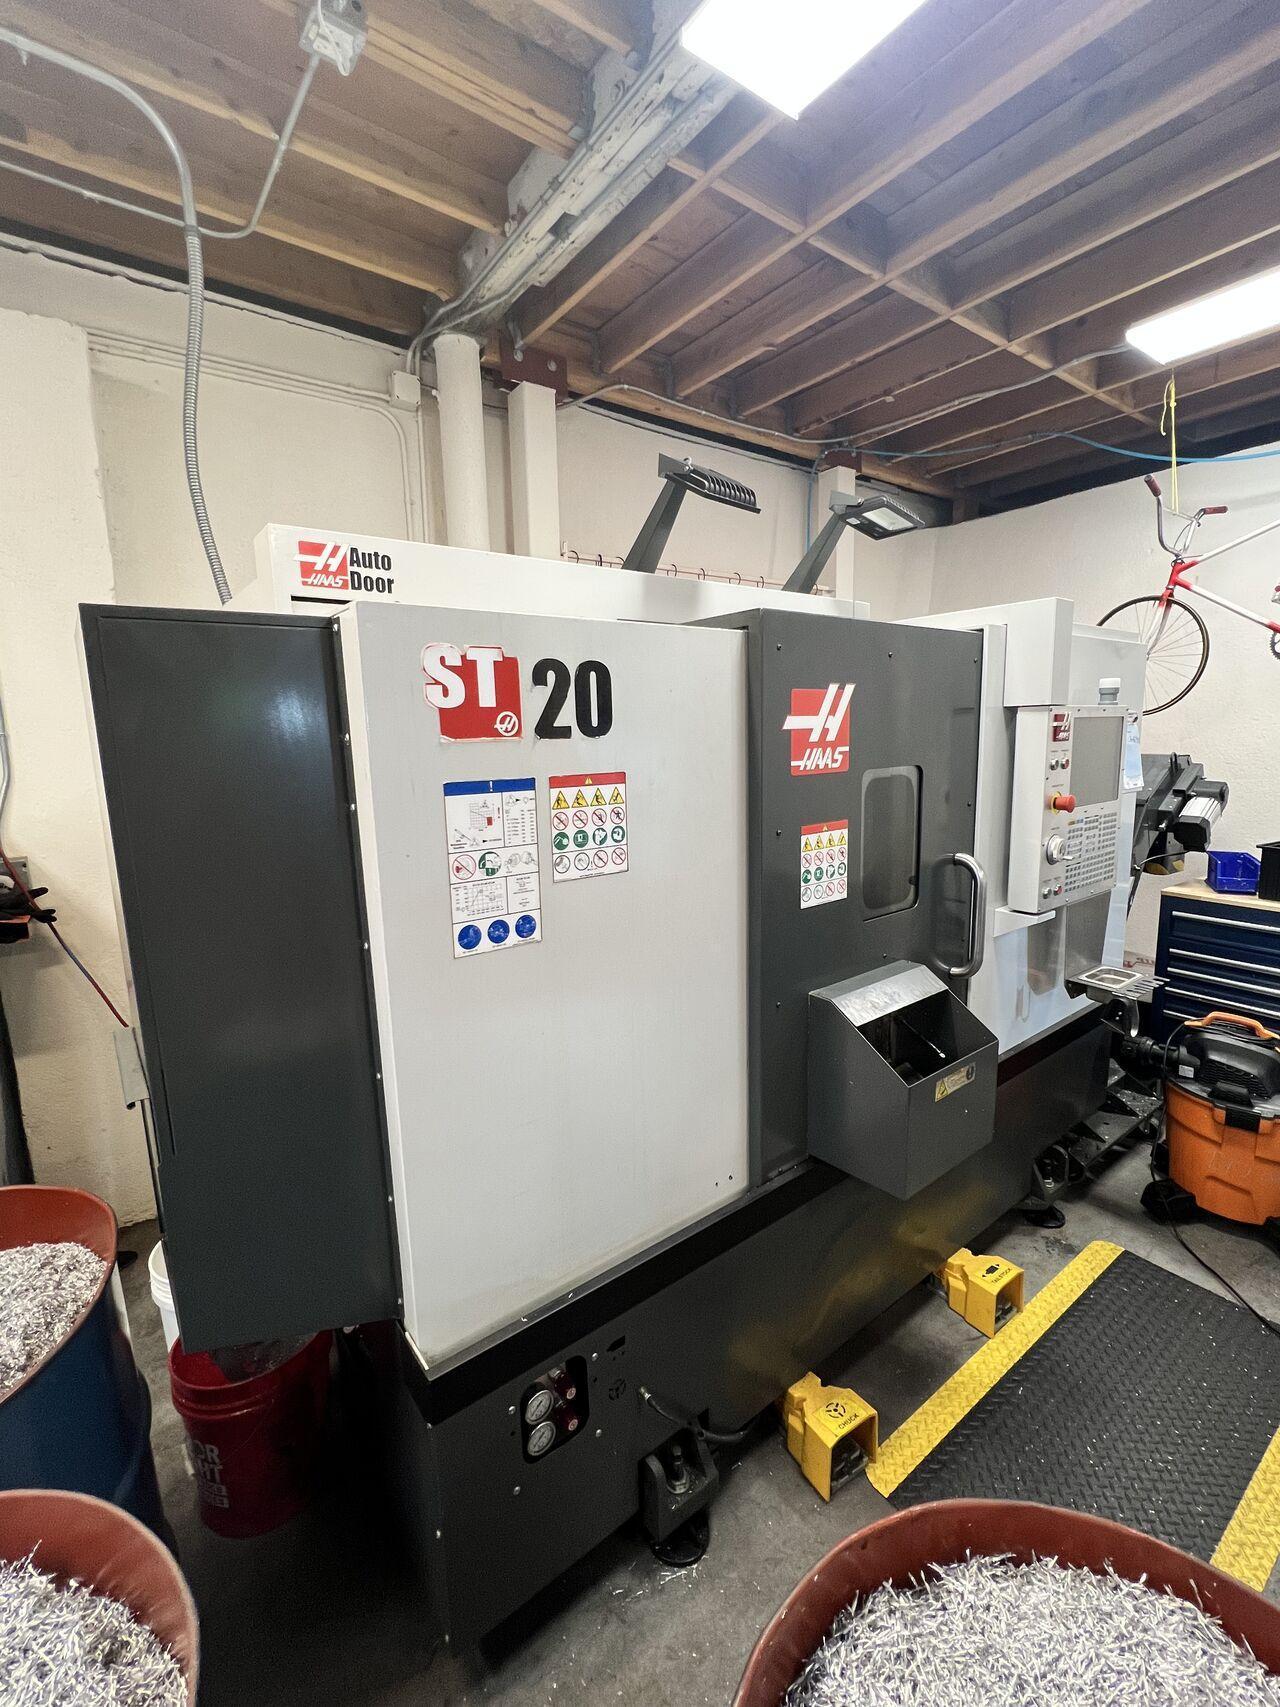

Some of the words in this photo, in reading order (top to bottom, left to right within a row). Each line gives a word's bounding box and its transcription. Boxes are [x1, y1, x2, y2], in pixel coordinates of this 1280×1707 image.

[350, 546, 392, 571] Auto
[301, 572, 348, 588] HAAS
[350, 571, 395, 594] Door
[423, 642, 504, 710] ST
[532, 658, 613, 739] 20
[791, 745, 849, 770] HAAS
[838, 1412, 860, 1429] CHUCK
